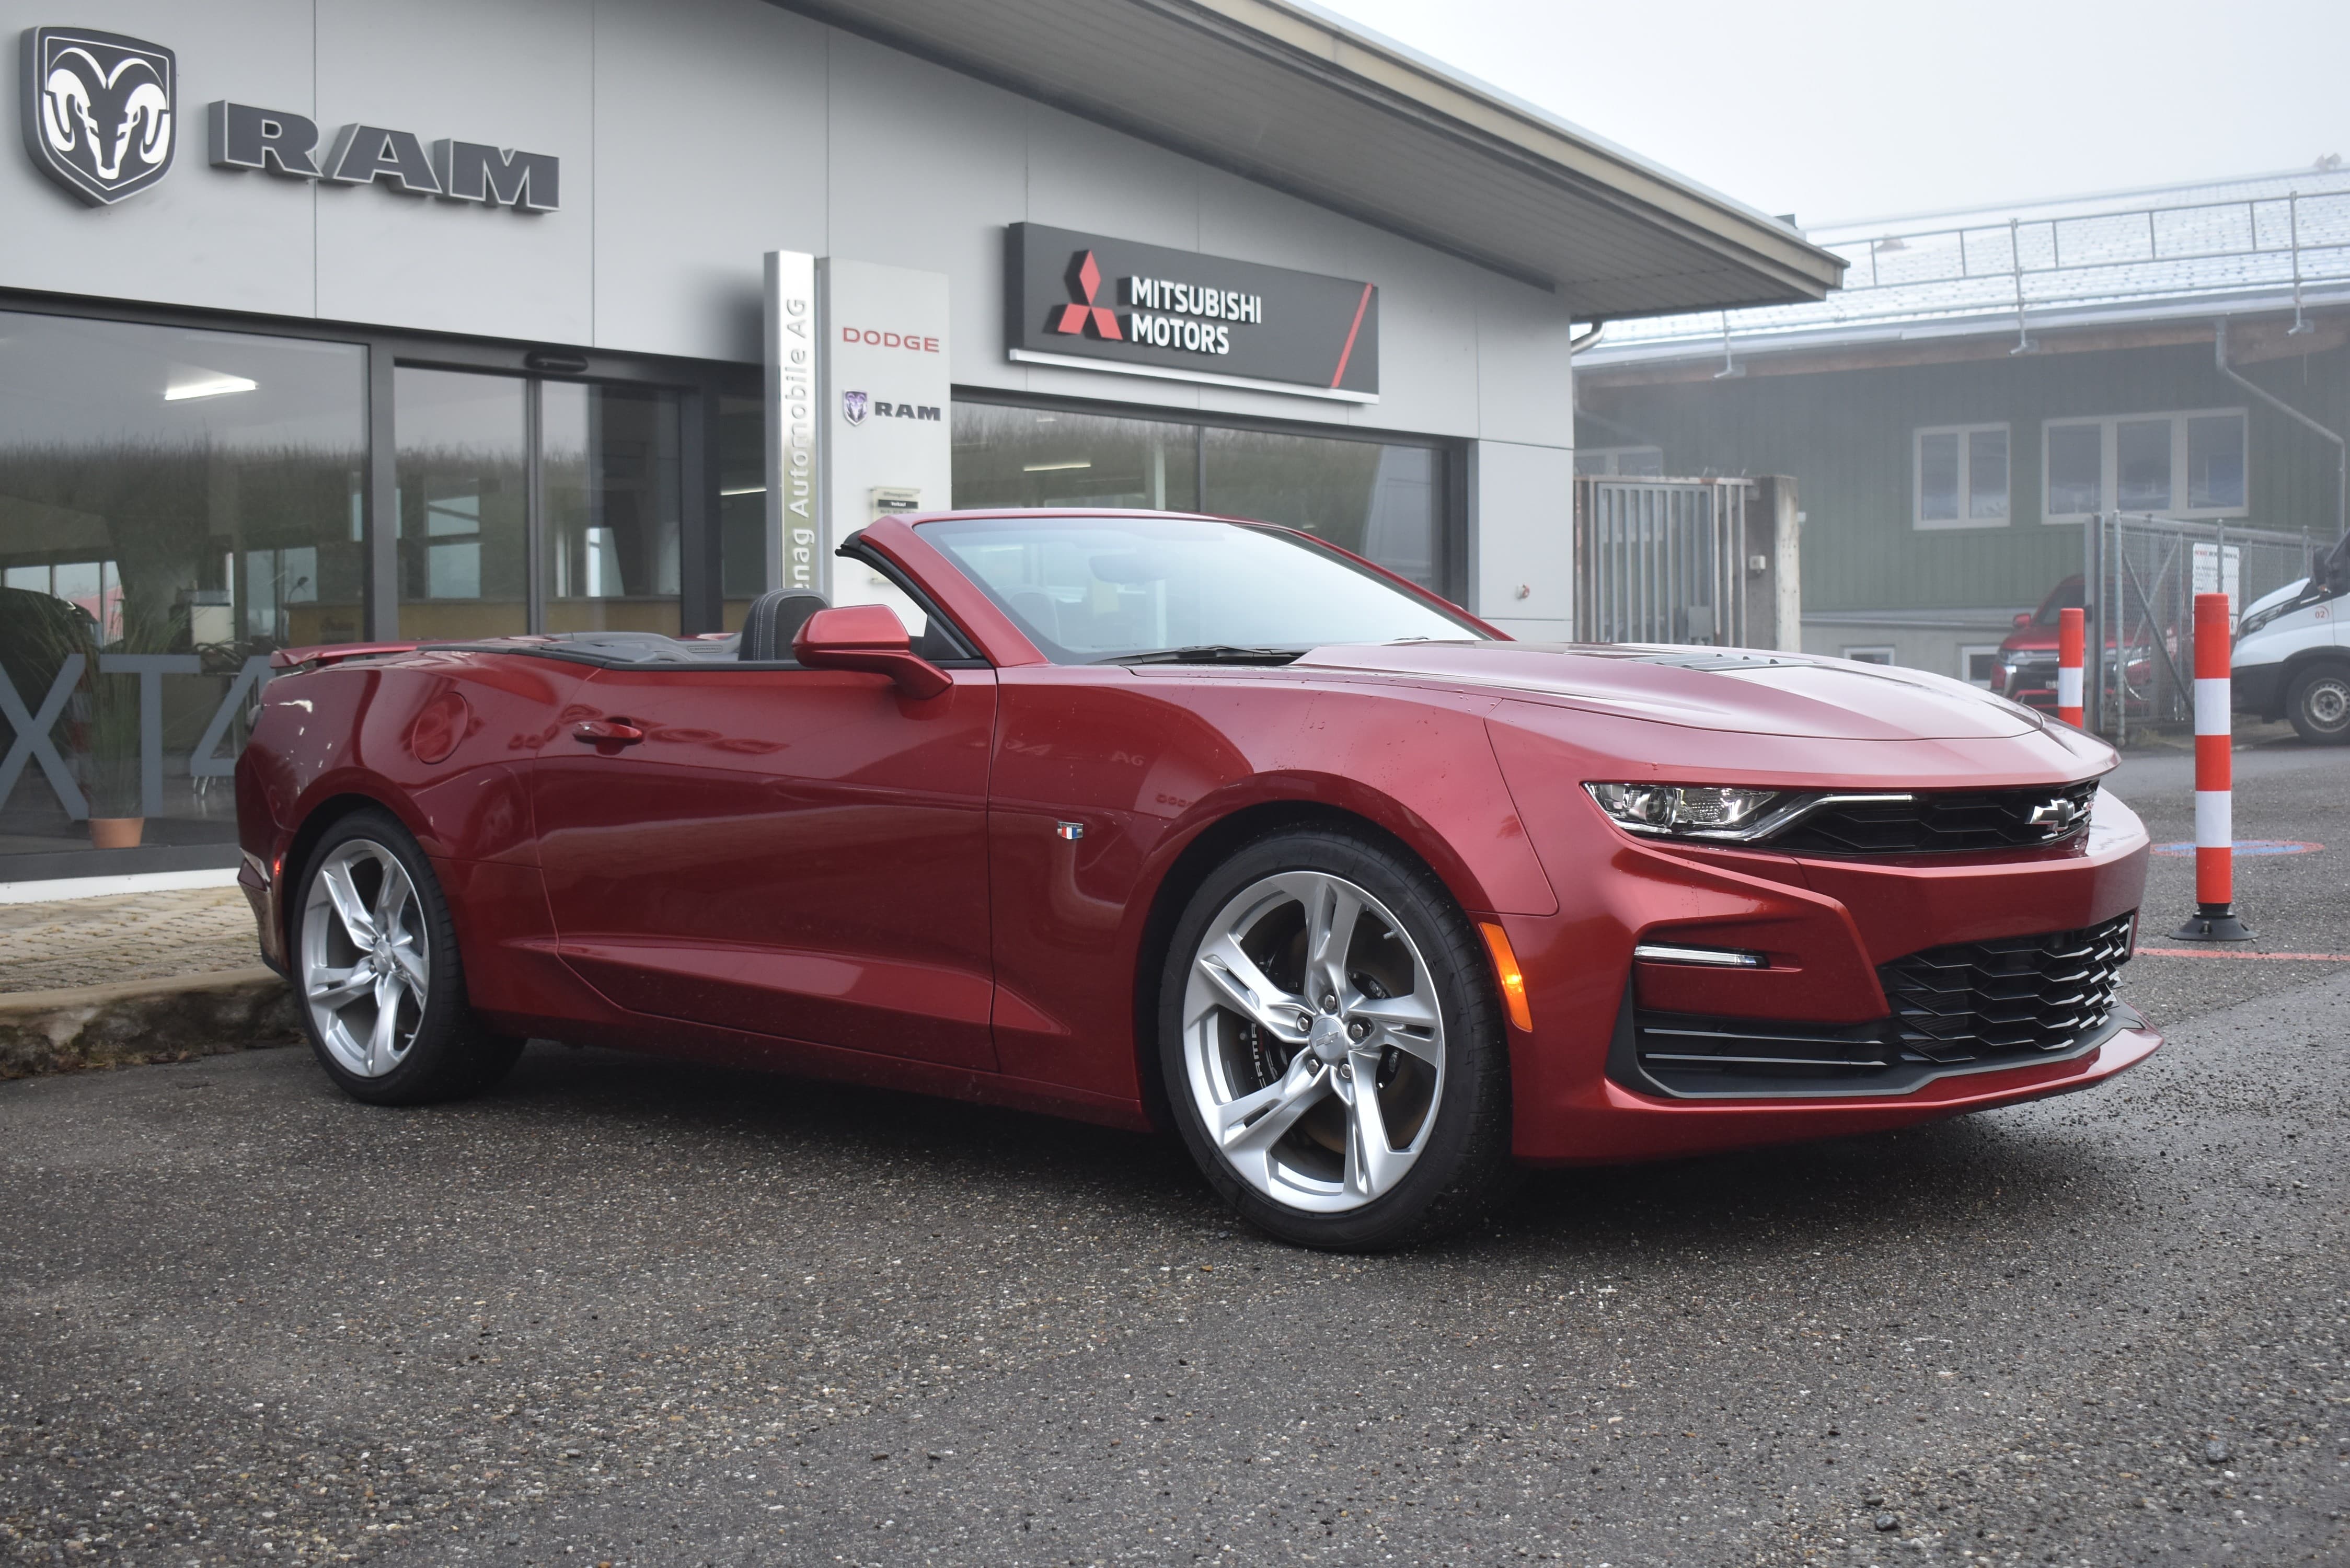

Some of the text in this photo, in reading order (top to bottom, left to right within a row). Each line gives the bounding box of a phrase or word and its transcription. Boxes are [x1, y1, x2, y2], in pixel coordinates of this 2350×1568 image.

[210, 100, 560, 212] RAM
[786, 298, 807, 339] AG
[1131, 276, 1262, 324] MITSUBISHI
[843, 327, 940, 353] DODGE
[1131, 314, 1229, 355] MOTORS
[874, 401, 941, 421] RAM
[785, 349, 810, 518] Automobile
